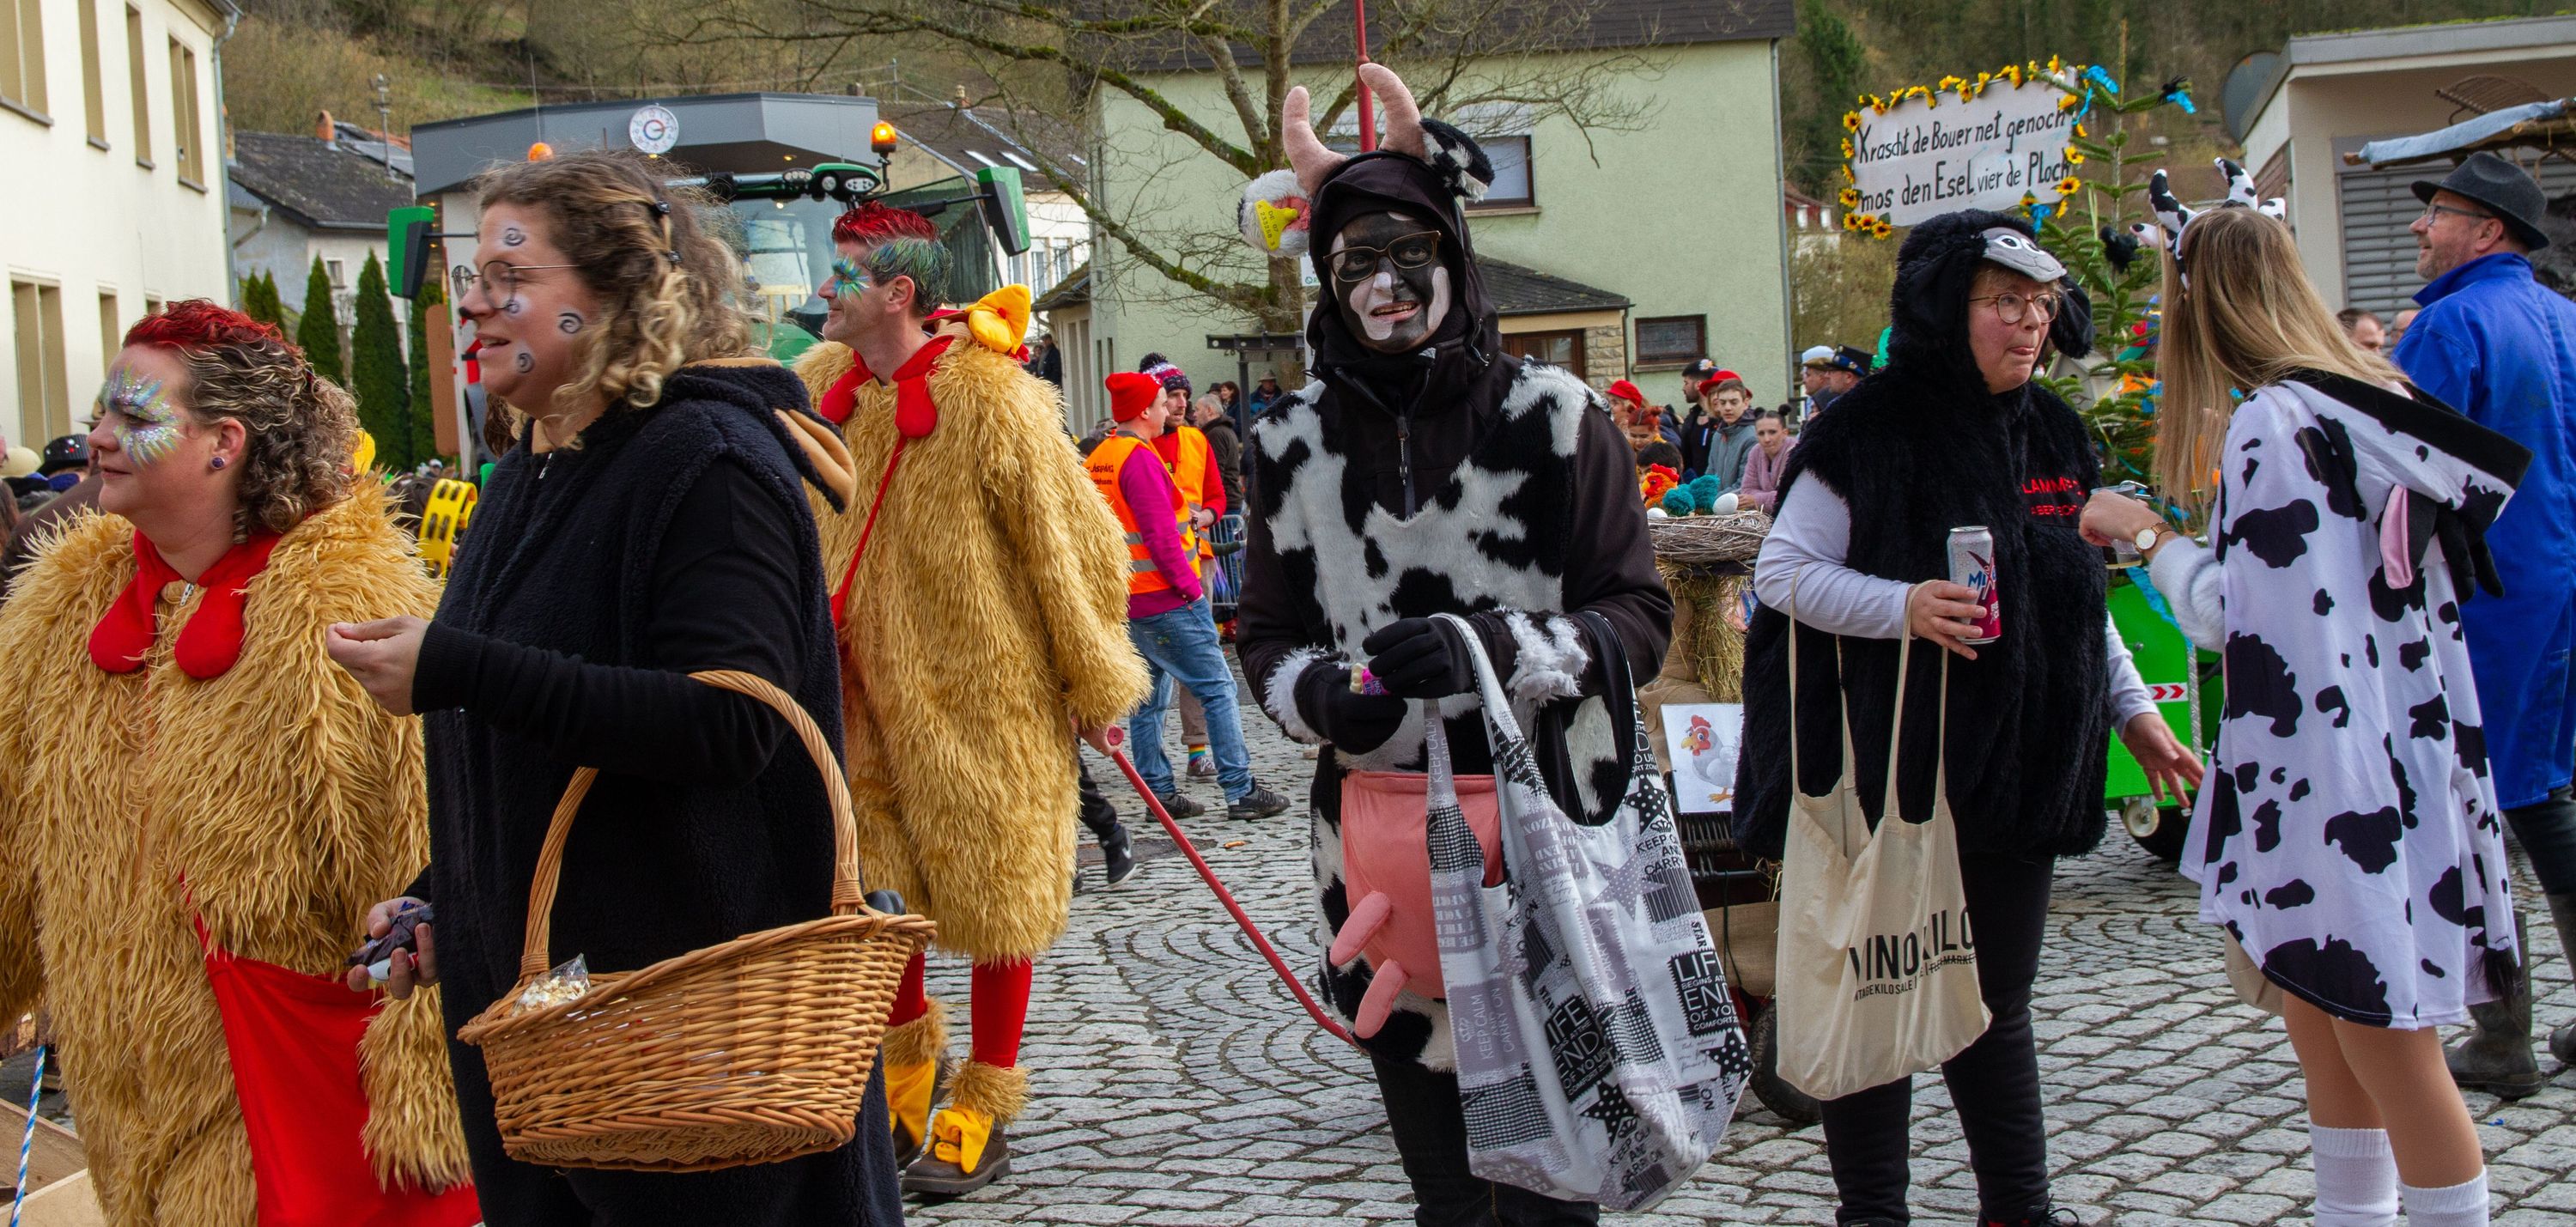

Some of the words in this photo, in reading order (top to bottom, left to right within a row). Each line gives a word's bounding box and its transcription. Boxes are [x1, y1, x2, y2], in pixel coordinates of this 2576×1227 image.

[1912, 125, 1929, 155] de
[1931, 120, 1971, 150] Bouer
[1975, 110, 2002, 143] net
[2005, 98, 2065, 155] genoch
[1861, 188, 1894, 213] mos
[1902, 173, 1930, 206] den
[1935, 160, 1974, 200] Esel
[1978, 167, 2003, 193] vier
[2006, 159, 2021, 187] de
[1425, 718, 1439, 750] CALM
[1429, 753, 1443, 783] KEEP
[1636, 834, 1667, 854] KEEP
[1492, 987, 1504, 1008] ON
[1680, 975, 1713, 990] BEGINS
[1874, 983, 1894, 995] KILO
[1895, 980, 1913, 995] SALE
[1471, 993, 1488, 1027] CALM
[1546, 998, 1589, 1044] IFE
[1690, 1009, 1708, 1024] OF
[1477, 1030, 1494, 1060] KEEP
[1498, 1012, 1515, 1053] CARRY
[1700, 1088, 1715, 1111] ON
